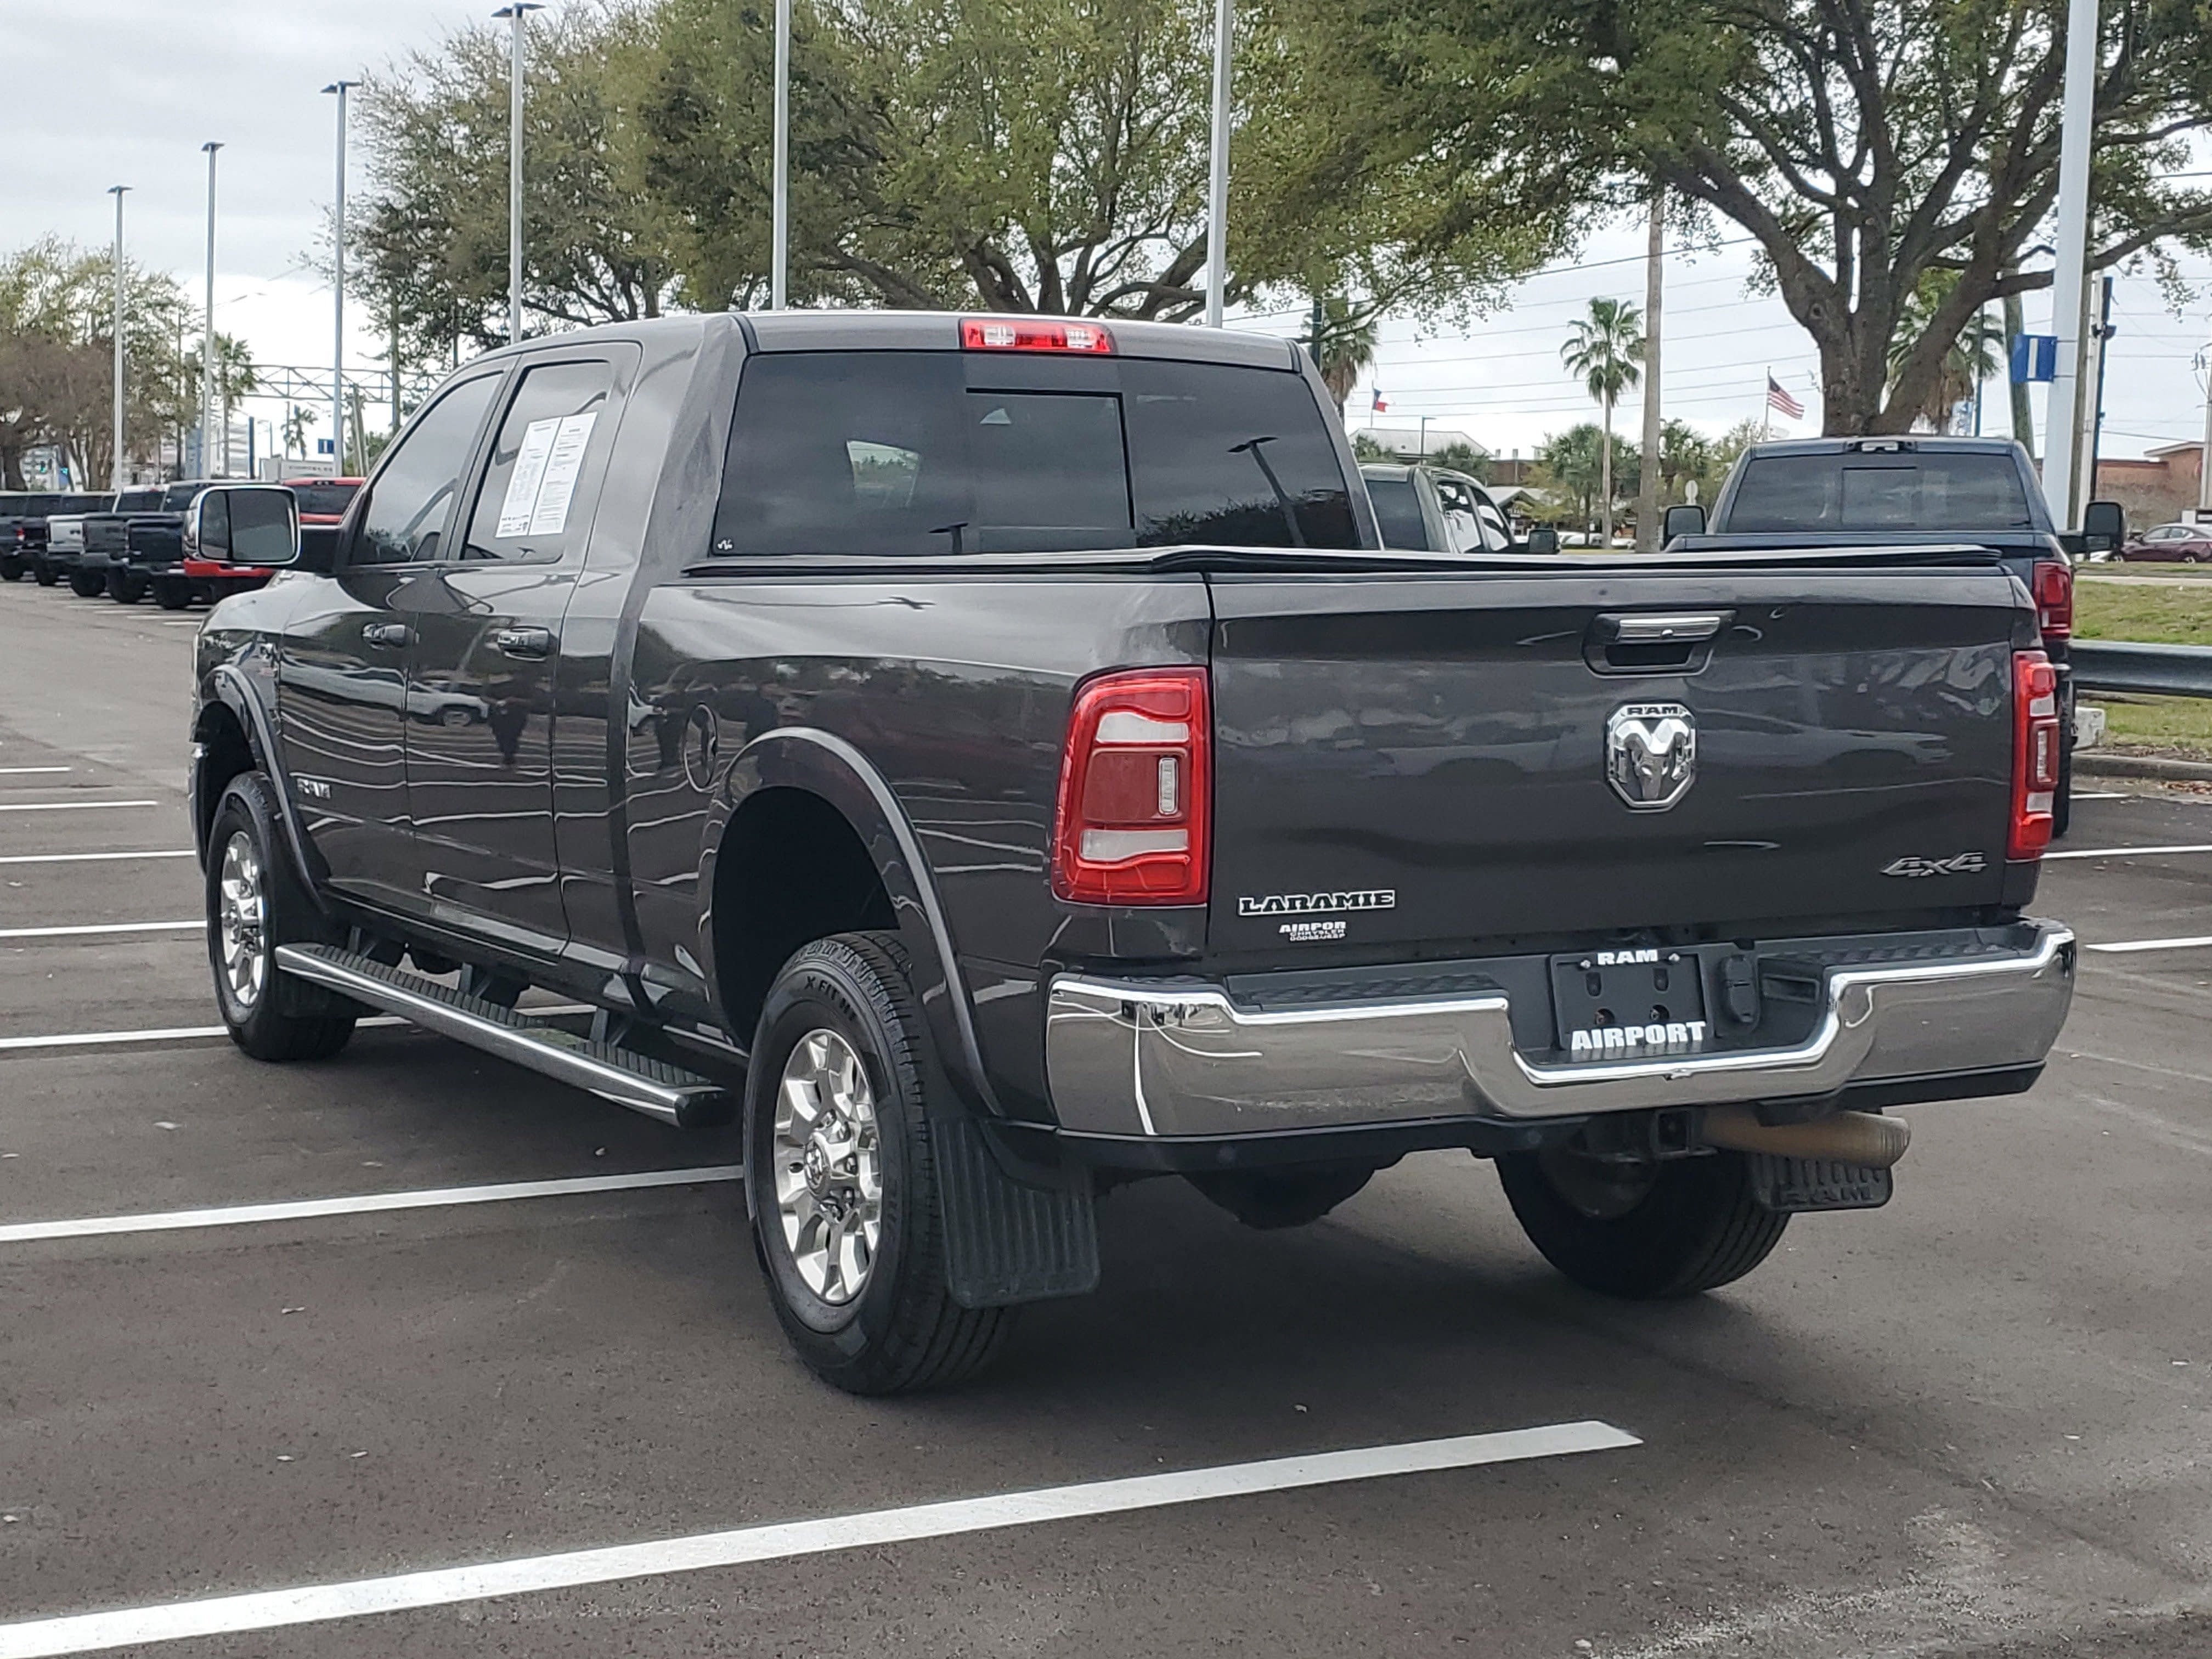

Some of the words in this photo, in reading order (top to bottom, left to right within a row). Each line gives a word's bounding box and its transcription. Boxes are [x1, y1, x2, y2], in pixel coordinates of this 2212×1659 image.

[1627, 706, 1678, 715] RAM
[1239, 890, 1395, 916] LARAMIE
[1597, 950, 1658, 966] RAM
[1571, 1021, 1706, 1050] AIRPORT
